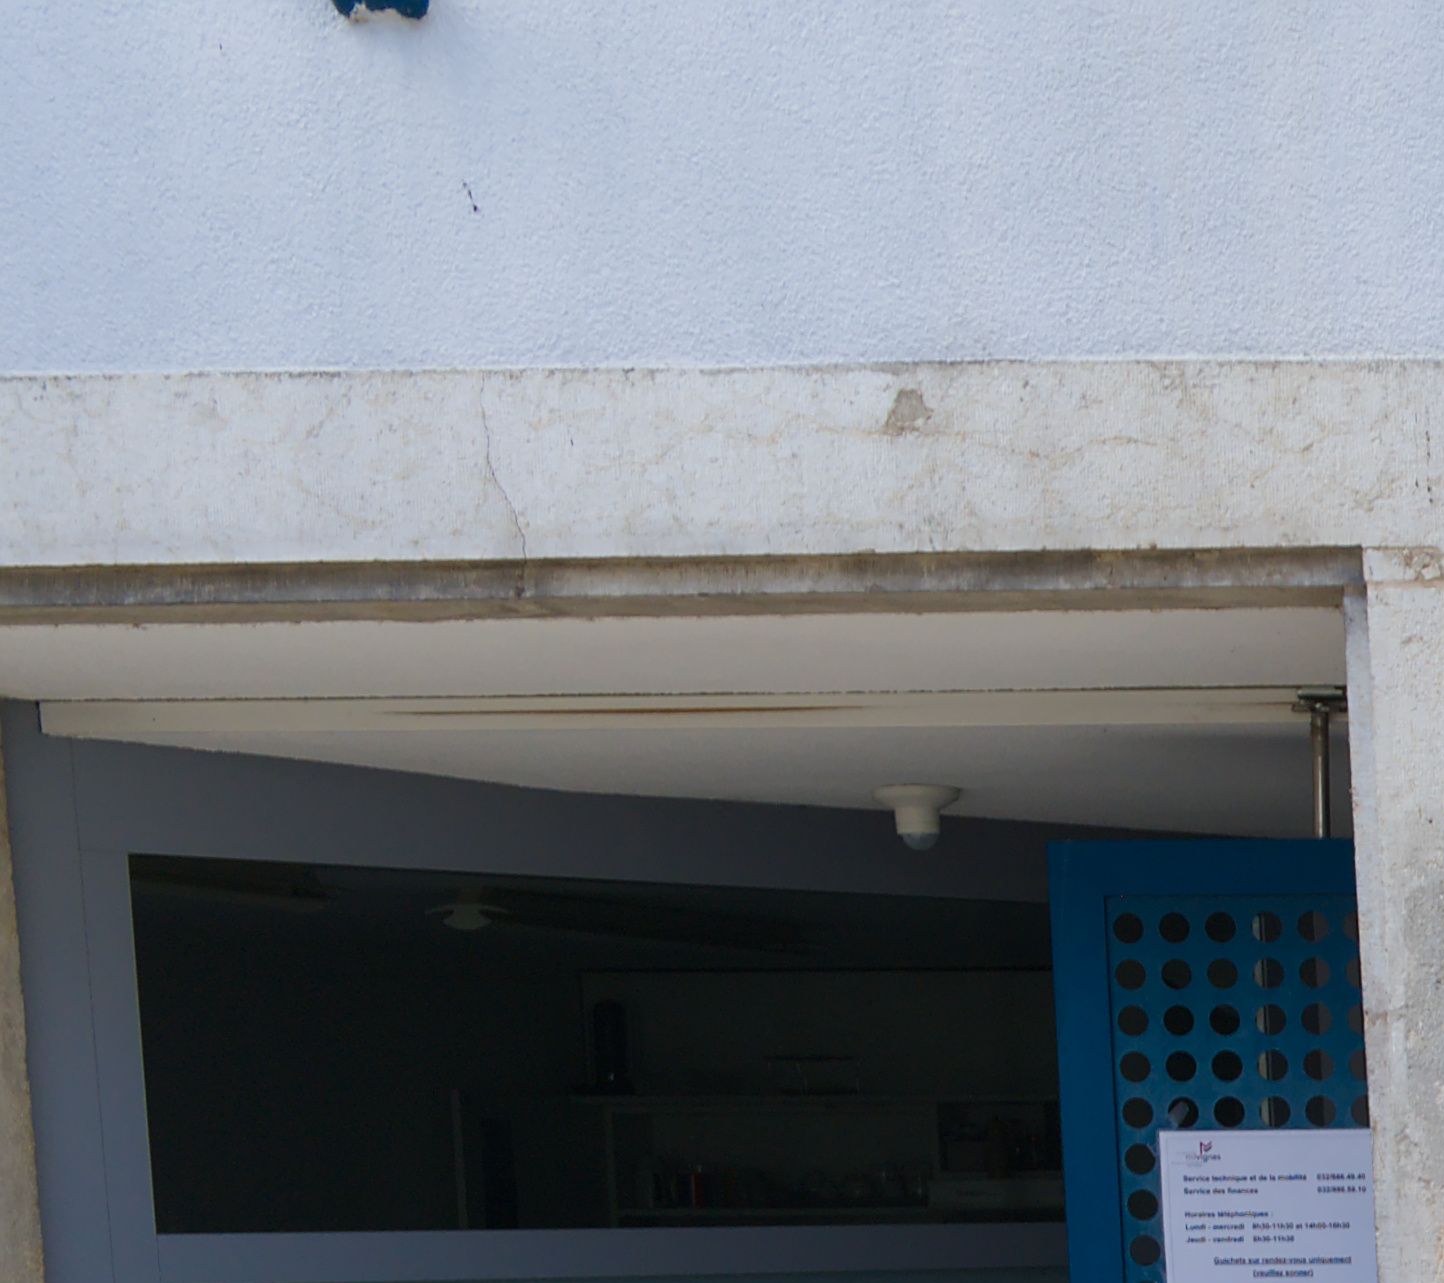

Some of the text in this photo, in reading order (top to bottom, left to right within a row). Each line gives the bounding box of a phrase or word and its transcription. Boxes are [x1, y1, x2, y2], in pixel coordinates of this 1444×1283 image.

[1183, 1172, 1307, 1184] Service technique et de la mobilité
[1183, 1186, 1259, 1196] Service des finances
[1184, 1208, 1269, 1220] Horaires téléphoniques
[1185, 1222, 1245, 1231] Lundi mercredi
[1186, 1234, 1245, 1244] Jeudi vendredi
[1213, 1256, 1247, 1266] Guichets
[1247, 1256, 1261, 1265] sur
[1261, 1256, 1307, 1265] rendez-vous
